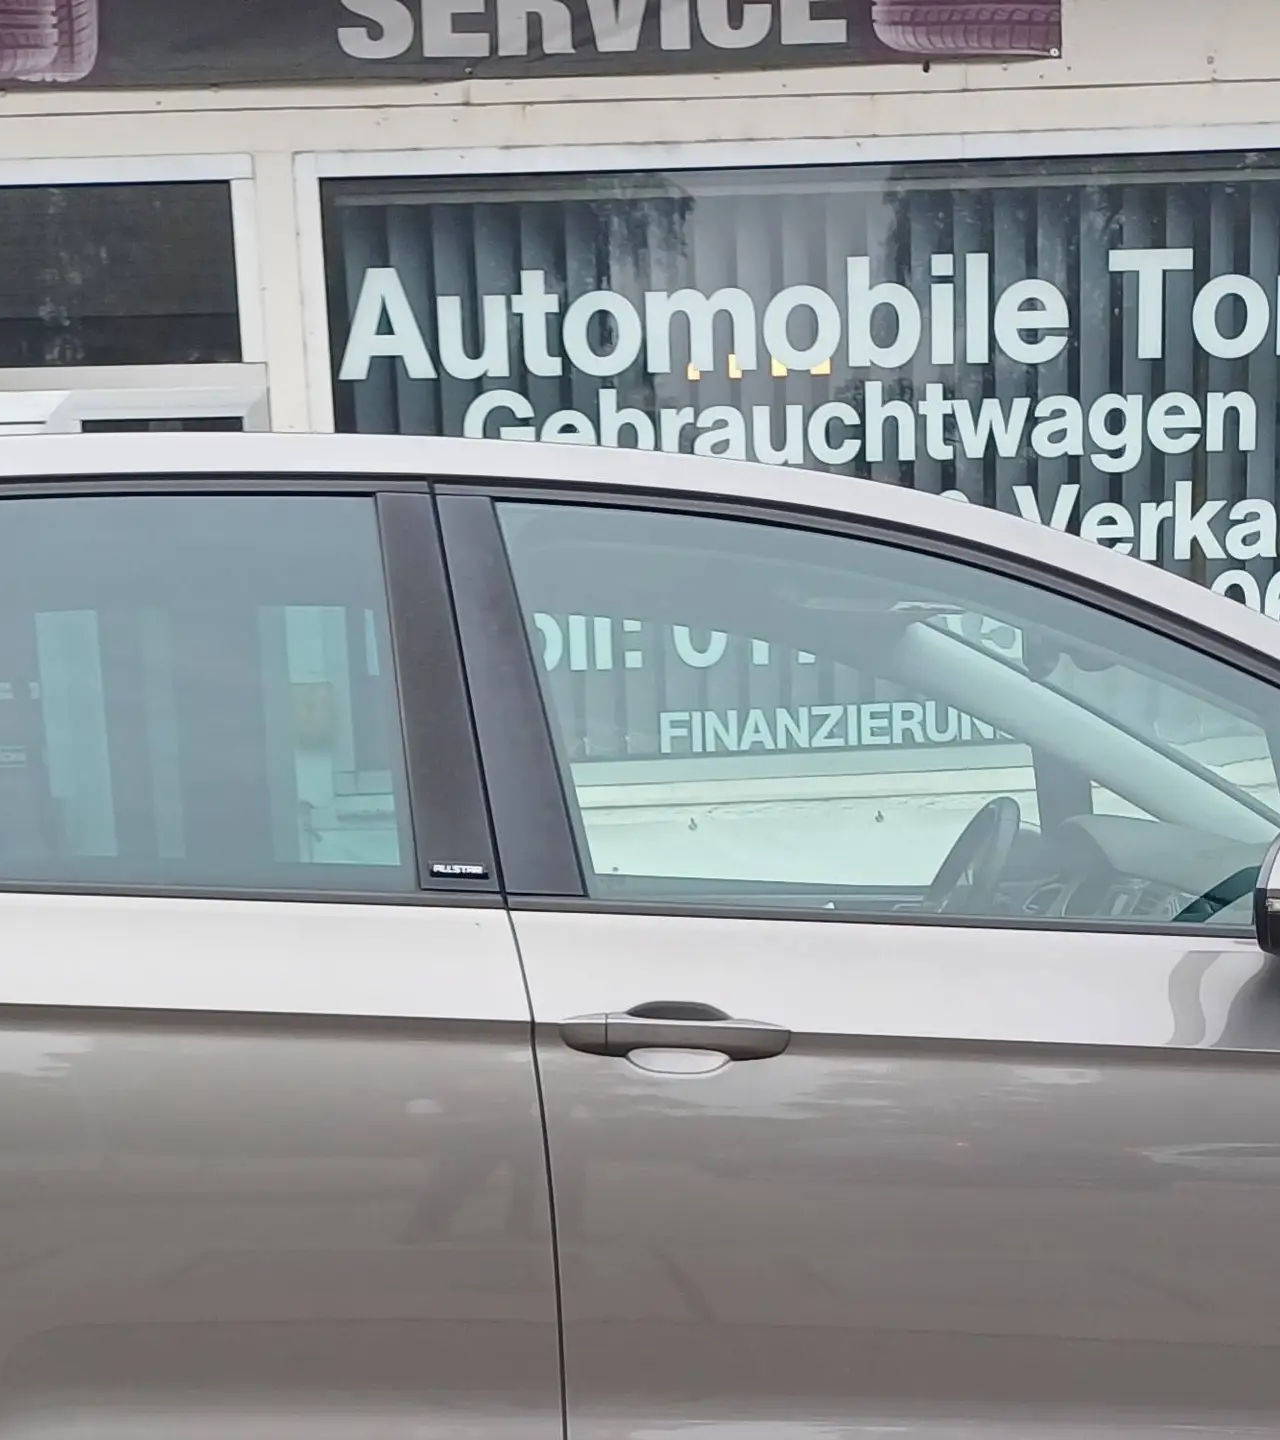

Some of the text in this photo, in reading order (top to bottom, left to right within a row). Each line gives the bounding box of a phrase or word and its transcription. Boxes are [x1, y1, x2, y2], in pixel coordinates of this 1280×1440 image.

[337, 253, 1072, 381] Automobile
[463, 380, 1257, 473] Gebrauchtwagen
[659, 700, 1015, 754] FINANZIERUN
